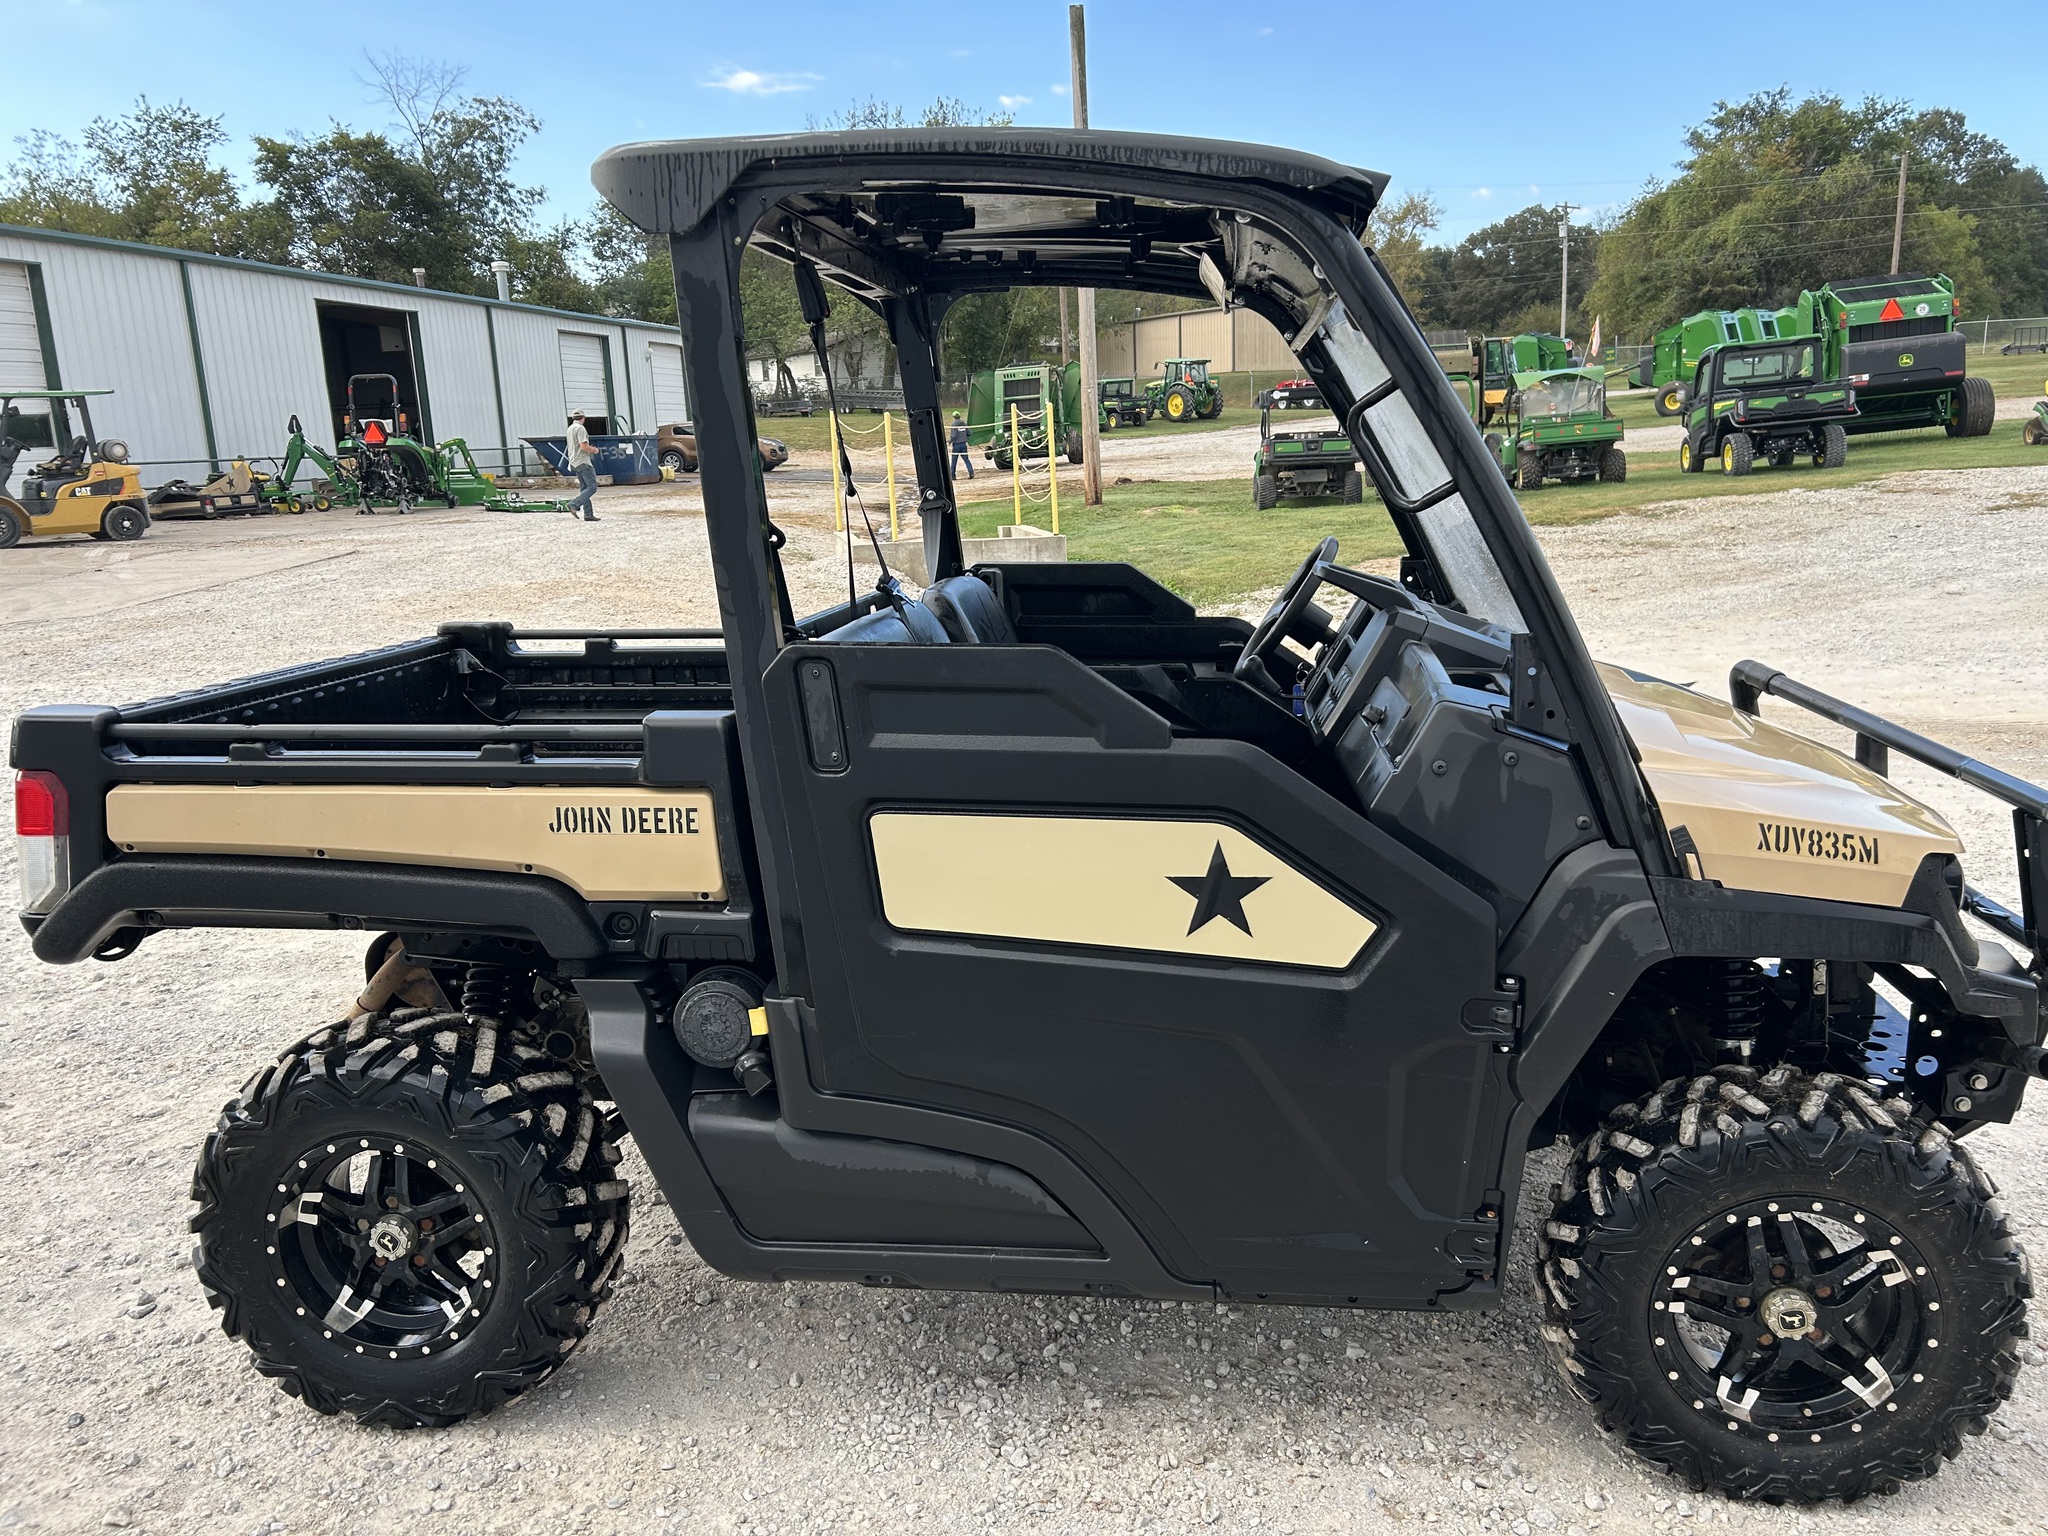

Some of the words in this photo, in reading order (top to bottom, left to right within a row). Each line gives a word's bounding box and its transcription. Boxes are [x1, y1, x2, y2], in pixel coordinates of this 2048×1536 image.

[75, 486, 91, 497] CAT
[548, 806, 611, 834] JOHN
[621, 807, 699, 834] DEERE
[1757, 822, 1879, 865] XUV835M
